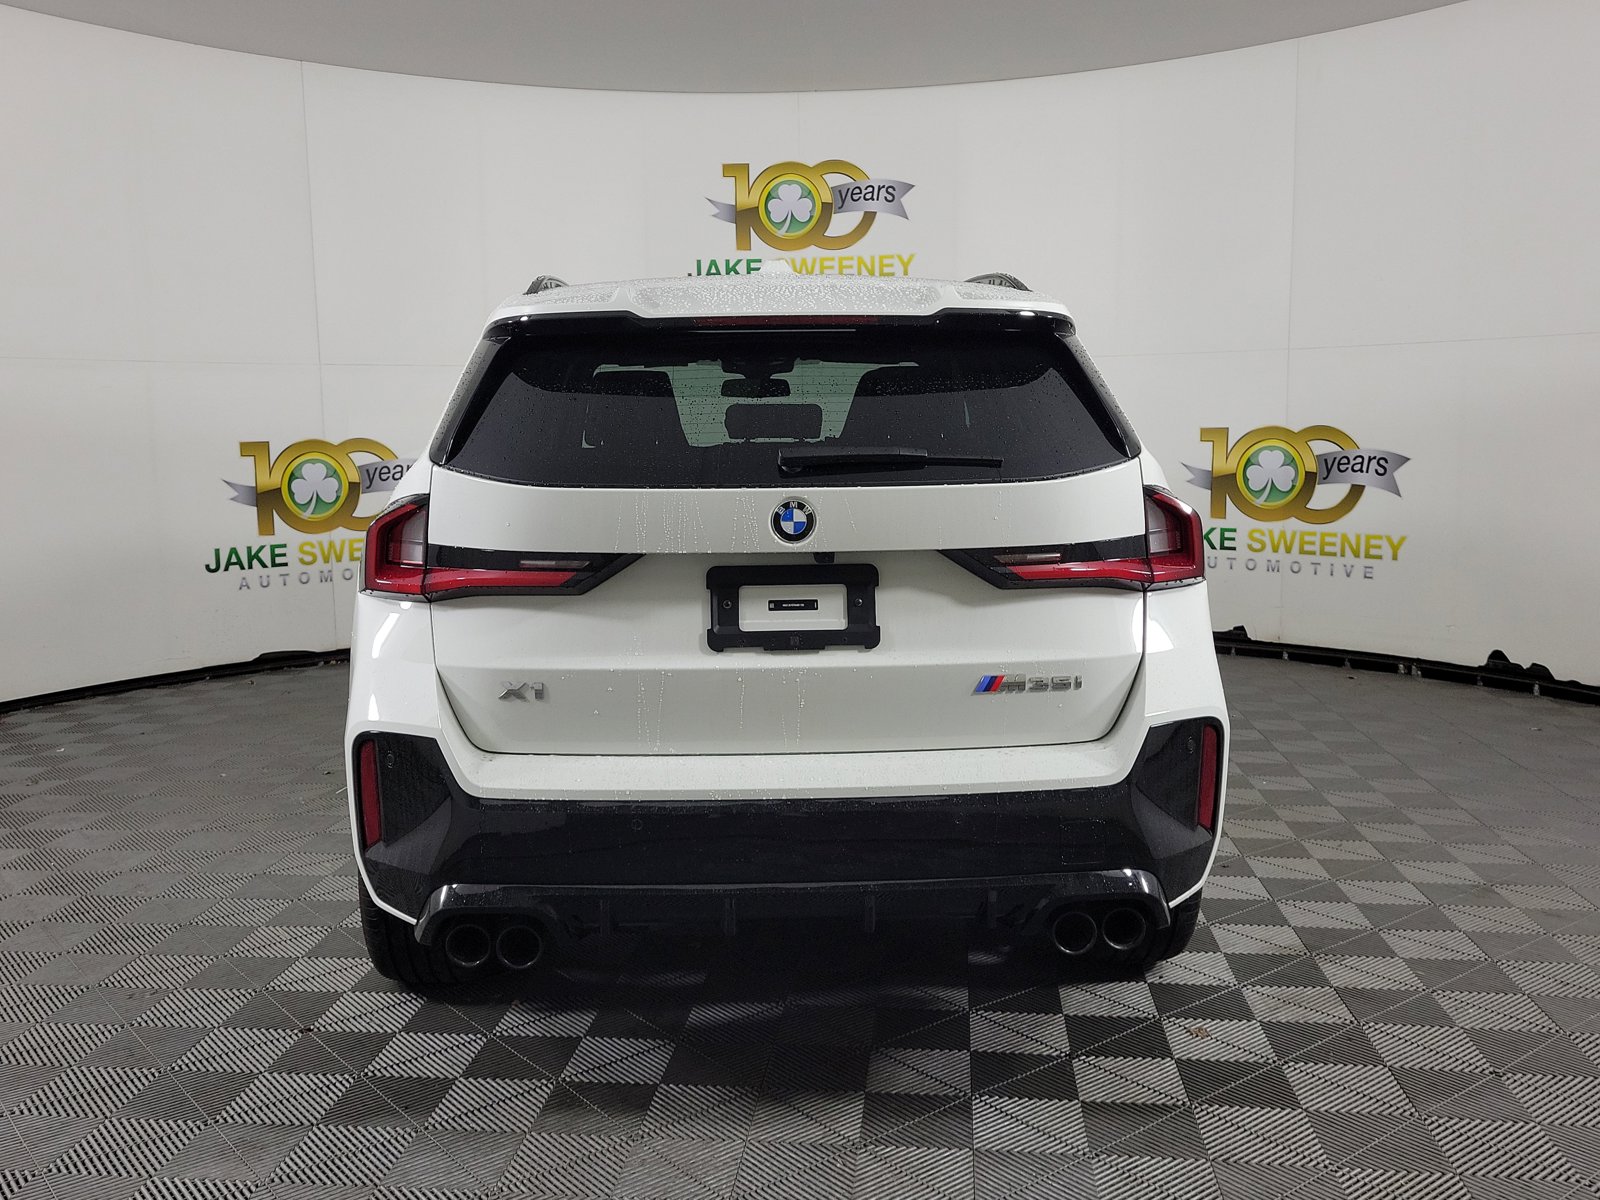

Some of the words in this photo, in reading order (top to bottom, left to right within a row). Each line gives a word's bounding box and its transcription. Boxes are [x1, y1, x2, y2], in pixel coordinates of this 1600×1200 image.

[722, 159, 877, 251] 100
[837, 183, 896, 209] years
[788, 252, 916, 276] WEENEY
[365, 464, 413, 489] yea
[1200, 425, 1366, 525] 100
[1322, 453, 1389, 480] years
[776, 501, 812, 515] BMW
[1203, 527, 1237, 551] KE
[1246, 528, 1408, 561] SWEENEY
[204, 543, 289, 574] JAKE
[1207, 556, 1375, 580] UTOMOTIVE
[238, 568, 354, 591] AUTOMO
[498, 681, 545, 700] X1
